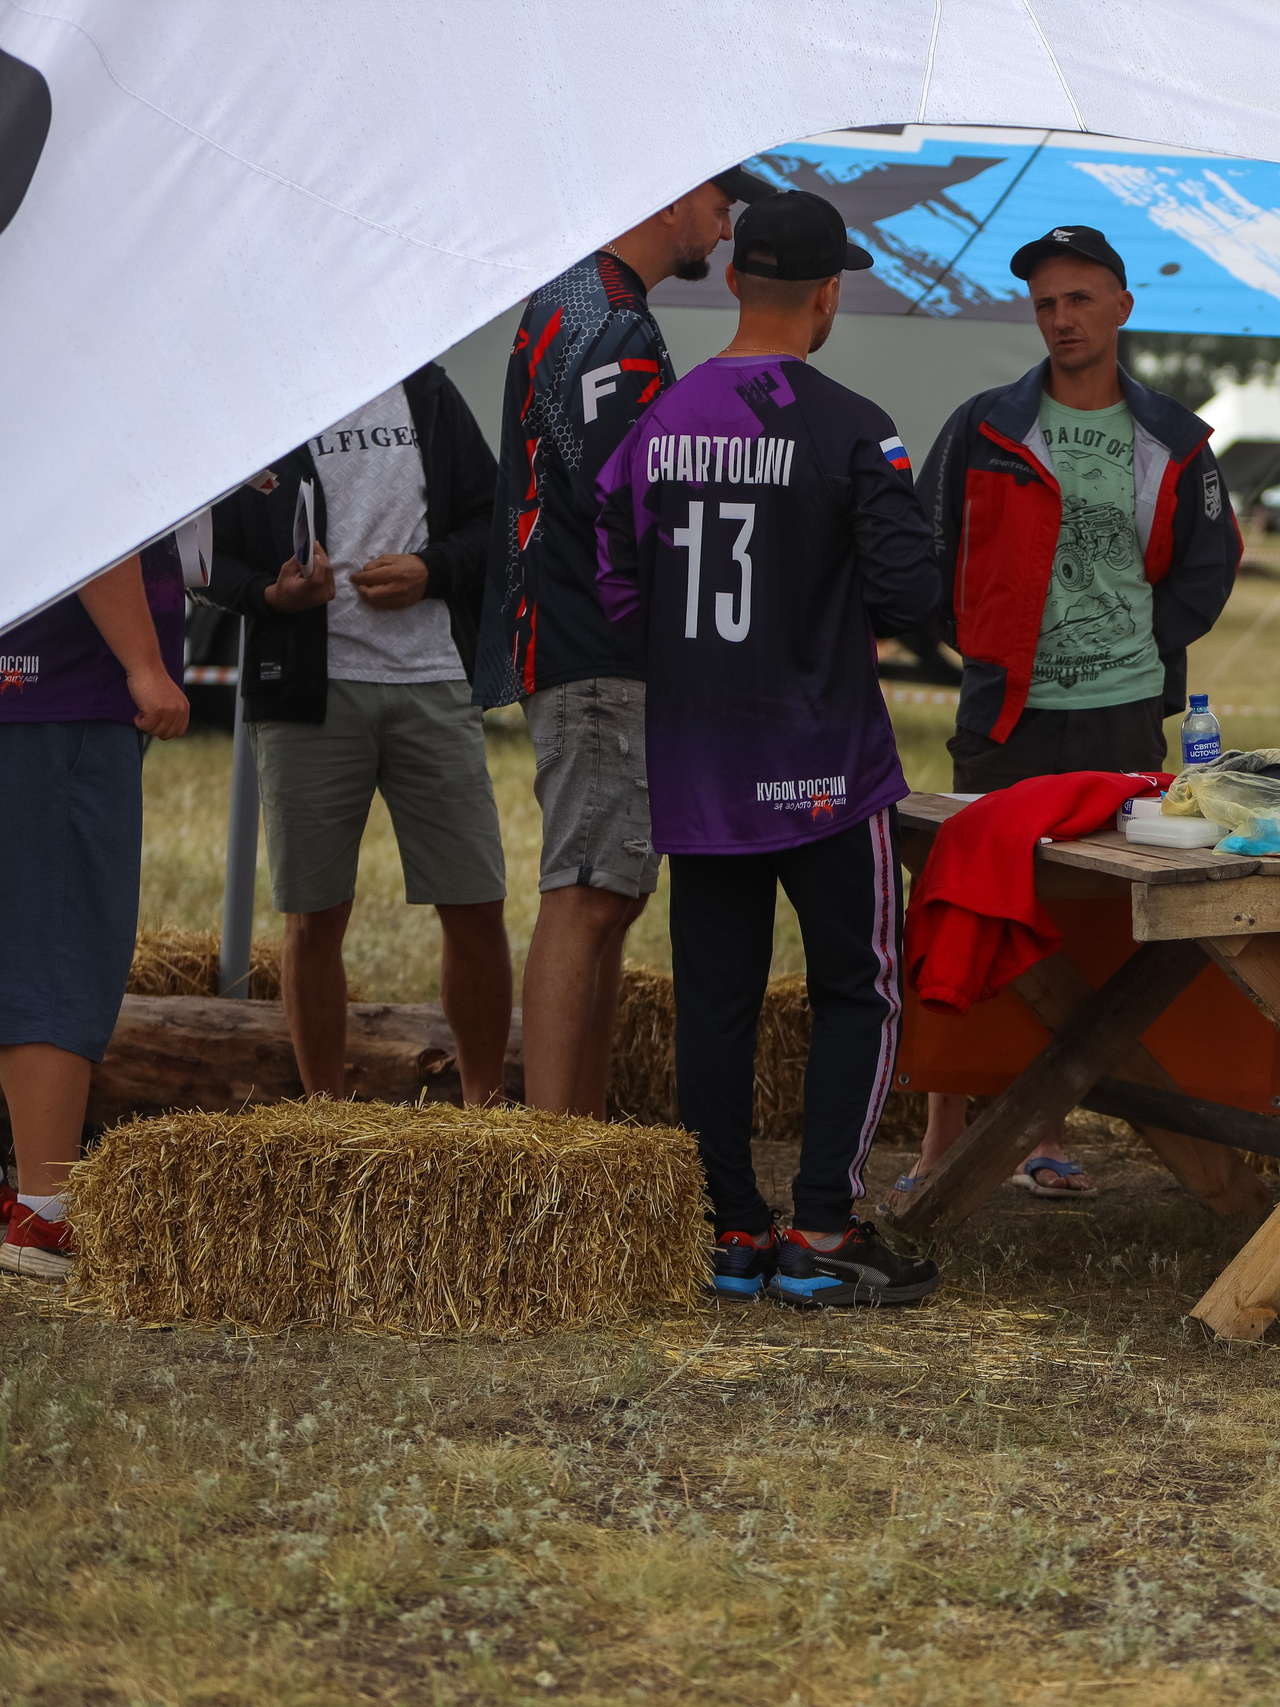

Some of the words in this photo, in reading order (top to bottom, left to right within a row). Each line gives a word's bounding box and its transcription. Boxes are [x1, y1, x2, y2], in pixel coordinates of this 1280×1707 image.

[1058, 426, 1069, 444] A
[1074, 426, 1106, 448] LOT
[1106, 439, 1129, 458] OF
[647, 434, 795, 486] CHARTOLANI
[673, 501, 756, 642] 13
[1038, 651, 1053, 664] SO
[1056, 654, 1073, 666] WE
[756, 780, 797, 802] КУБОК
[798, 775, 846, 800] РОССИИ
